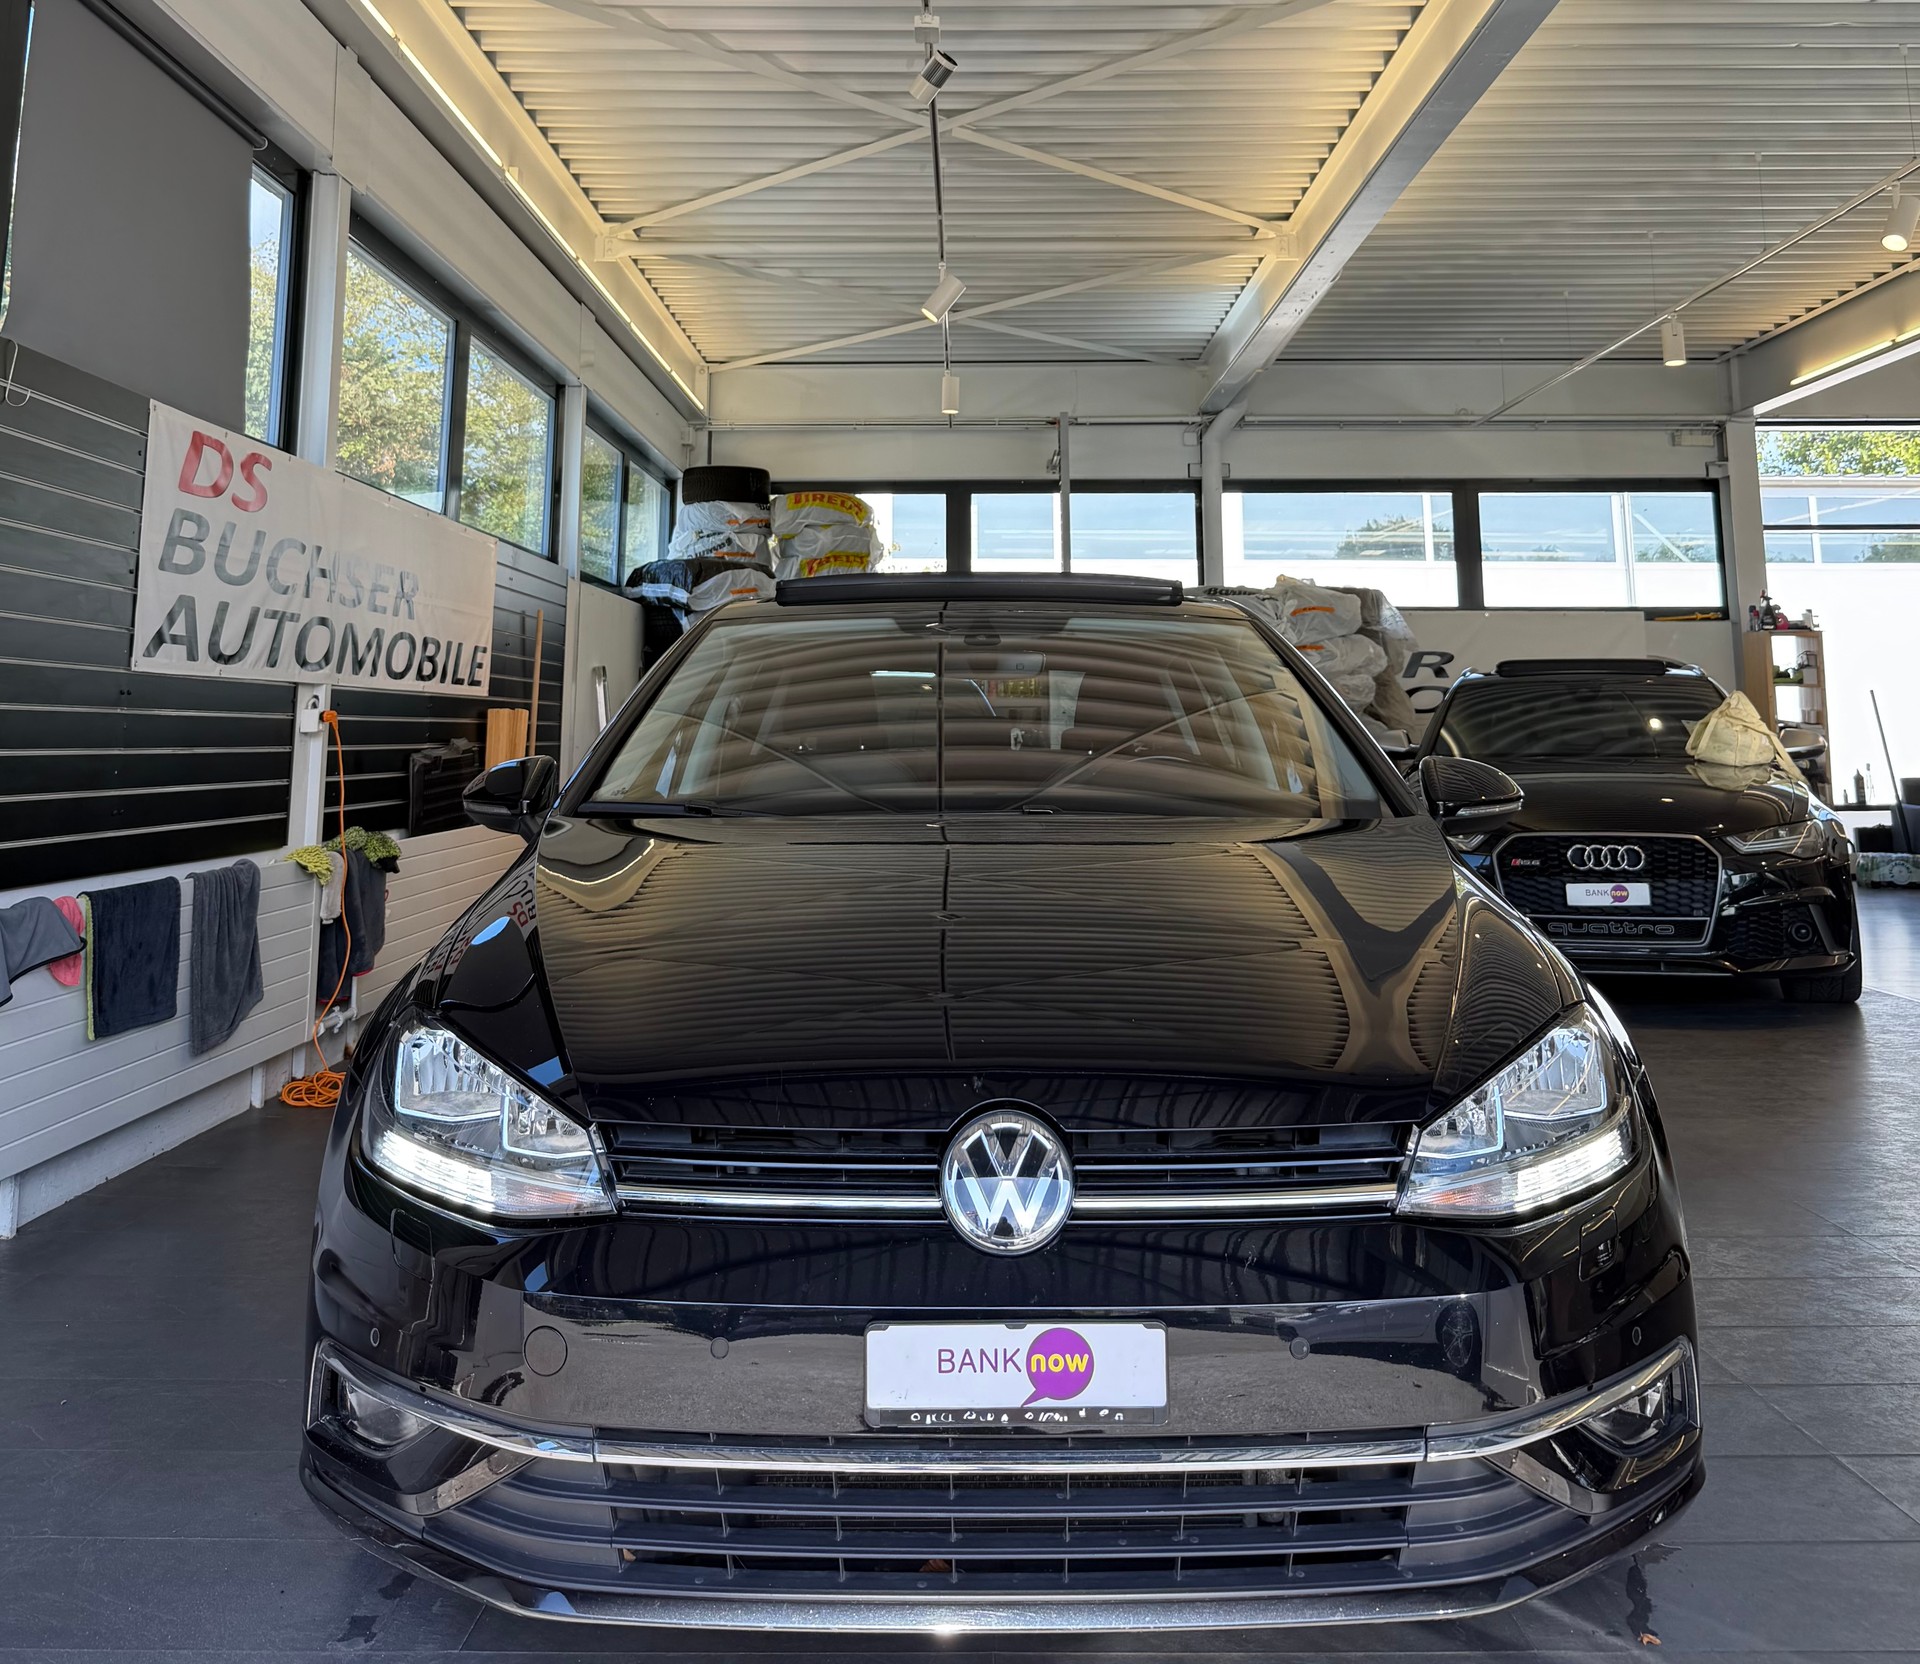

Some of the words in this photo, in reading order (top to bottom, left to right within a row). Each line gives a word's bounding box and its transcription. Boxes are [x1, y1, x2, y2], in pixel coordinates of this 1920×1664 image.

[178, 430, 273, 513] DS
[157, 507, 421, 621] BUCHSER
[142, 594, 489, 688] AUTOMOBILE
[1585, 889, 1610, 897] BANK
[1547, 921, 1676, 936] quattro
[937, 1348, 1022, 1374] BANK
[1030, 1353, 1090, 1374] now
